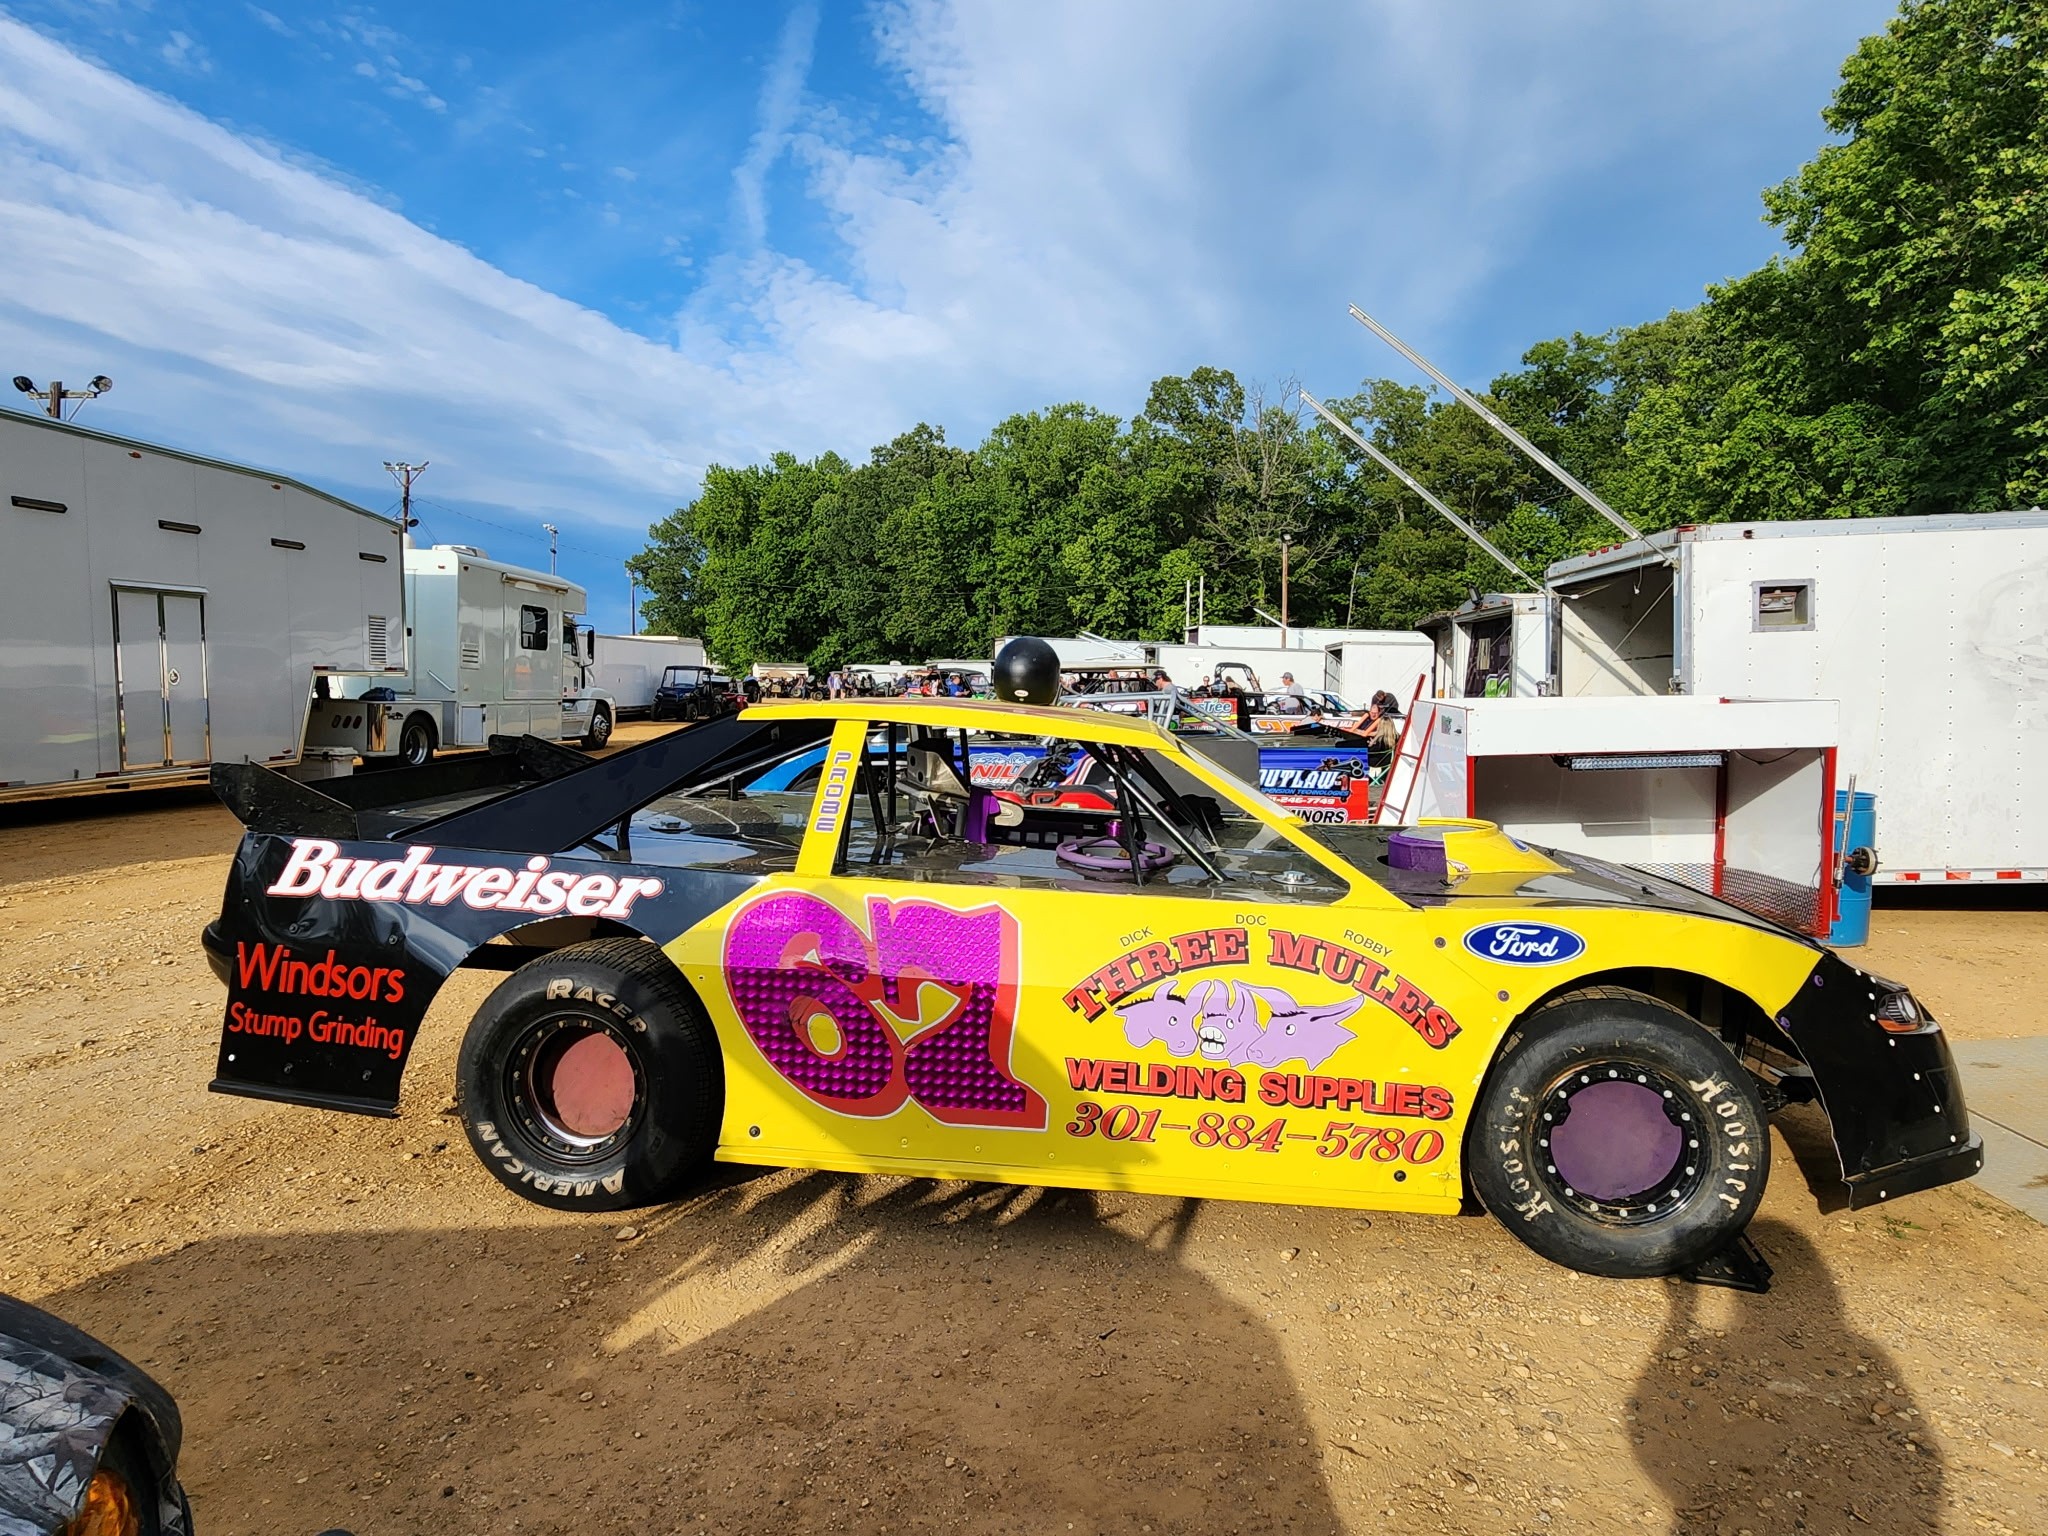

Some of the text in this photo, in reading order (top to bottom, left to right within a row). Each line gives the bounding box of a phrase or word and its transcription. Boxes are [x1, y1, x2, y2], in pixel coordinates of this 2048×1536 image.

[815, 751, 852, 832] PROBE
[265, 838, 664, 919] Budweiser
[1119, 926, 1154, 947] DICK
[1235, 914, 1267, 926] DOC
[1343, 929, 1393, 958] ROBBY
[1489, 926, 1559, 957] Ford
[237, 941, 406, 1003] Windsors
[1062, 928, 1463, 1050] THREE MULES
[228, 1001, 404, 1060] Stump Grinding
[1065, 1057, 1454, 1121] WELDING SUPPLIES
[1065, 1101, 1444, 1165] 301-884-5780
